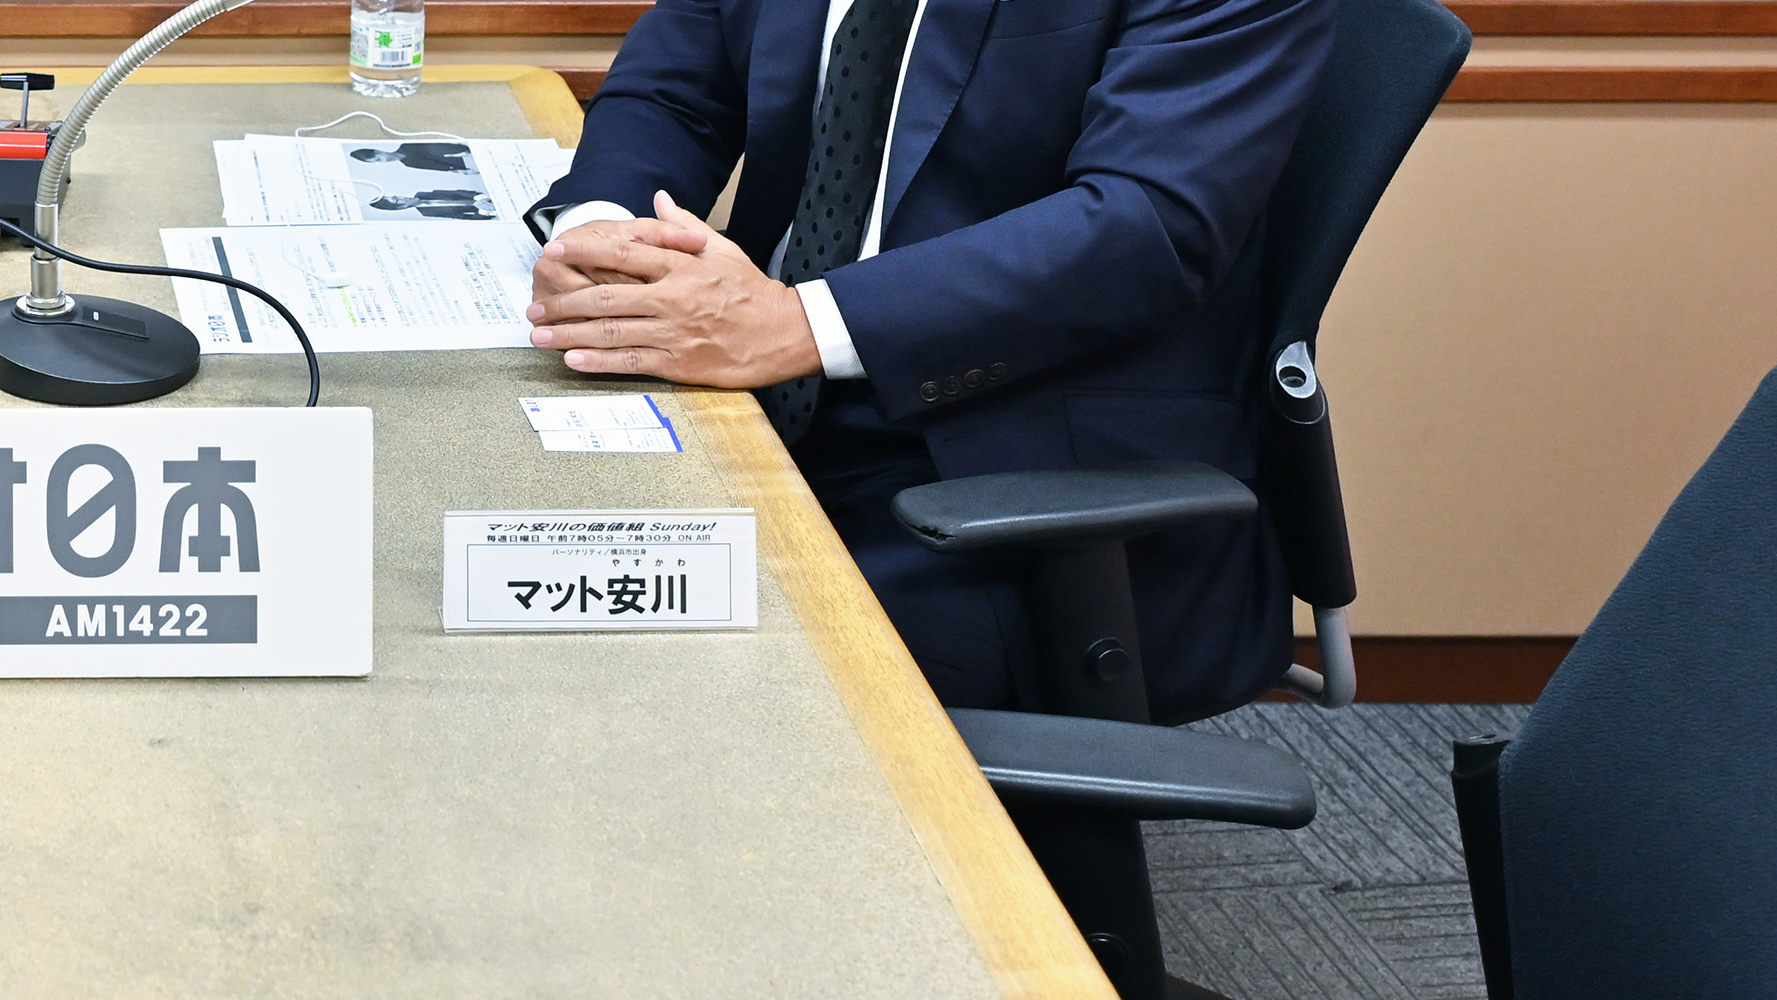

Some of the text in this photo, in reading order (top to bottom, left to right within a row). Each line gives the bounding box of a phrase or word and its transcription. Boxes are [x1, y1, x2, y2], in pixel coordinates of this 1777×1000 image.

[488, 522, 717, 532] マット安川の価値組 Sunday!
[612, 558, 686, 567] やすかわ
[507, 574, 687, 614] マット安川
[45, 604, 208, 637] AM1422
